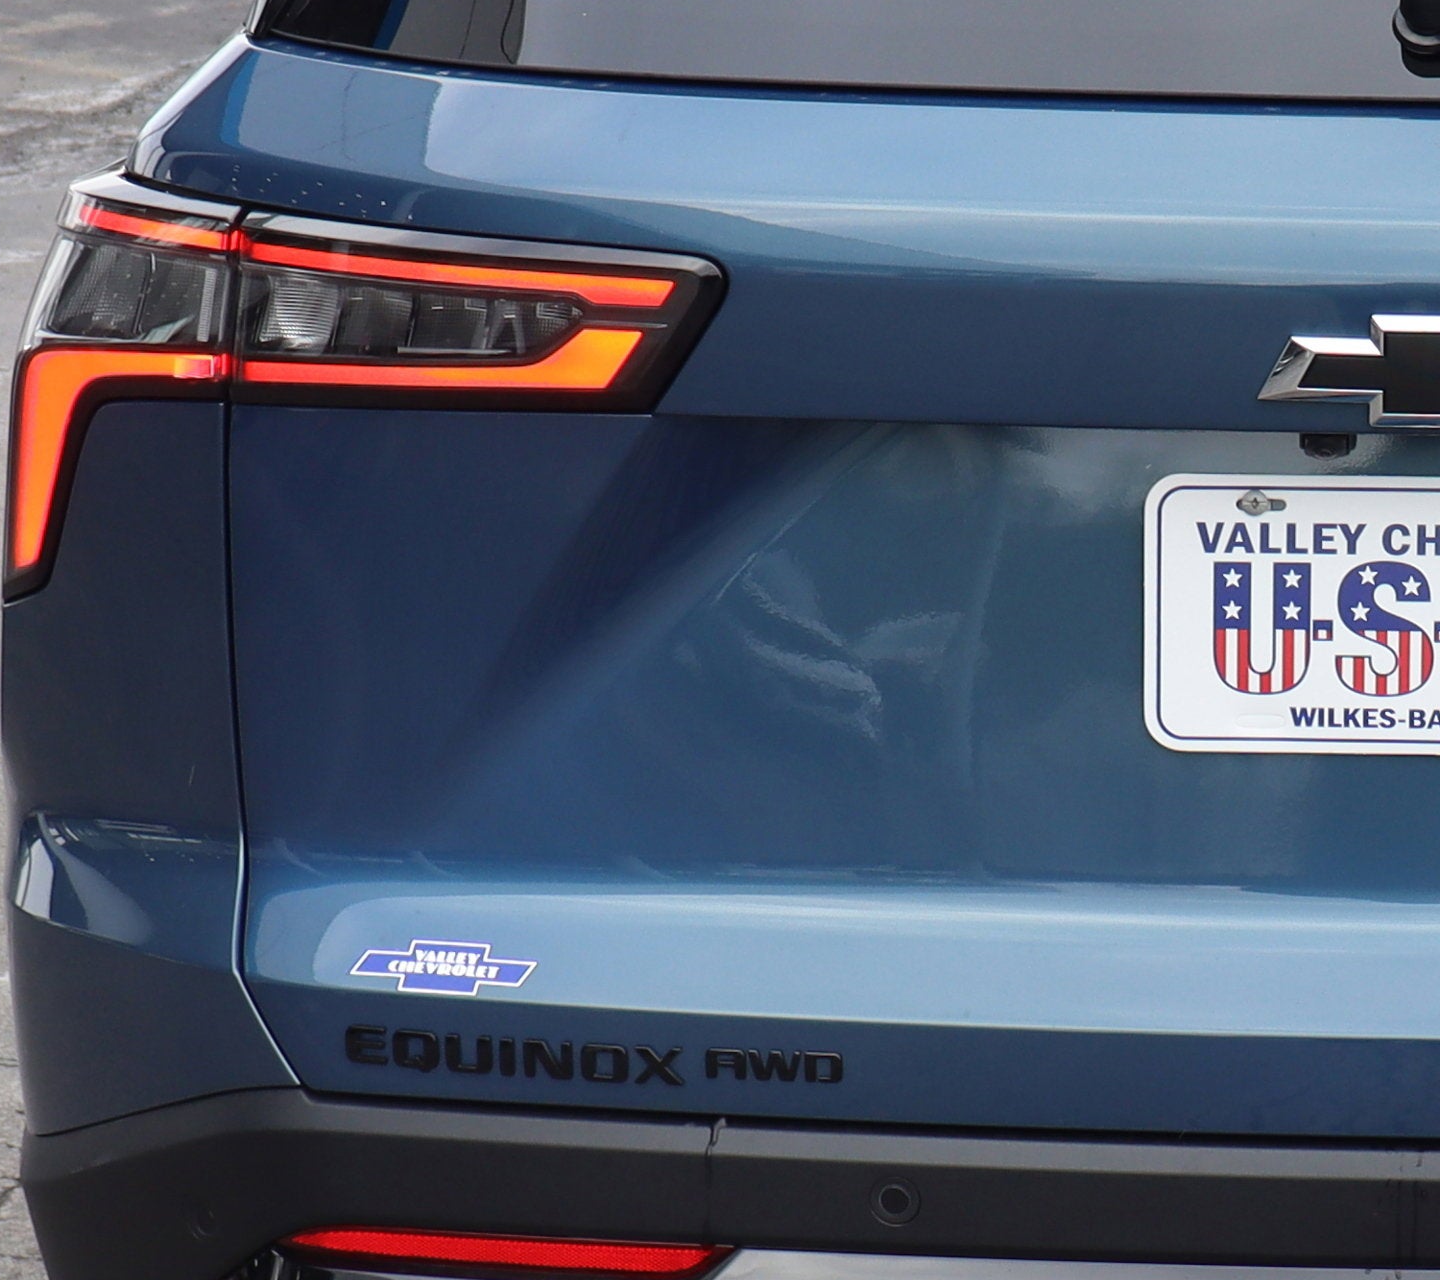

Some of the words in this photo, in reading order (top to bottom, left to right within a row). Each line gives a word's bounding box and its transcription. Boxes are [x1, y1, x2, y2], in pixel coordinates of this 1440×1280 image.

[1196, 521, 1367, 555] VALLEY
[387, 959, 500, 979] CHEVROLET
[415, 949, 481, 964] VALLEY
[345, 1024, 685, 1087] EQUINOX
[704, 1047, 844, 1084] AWD
